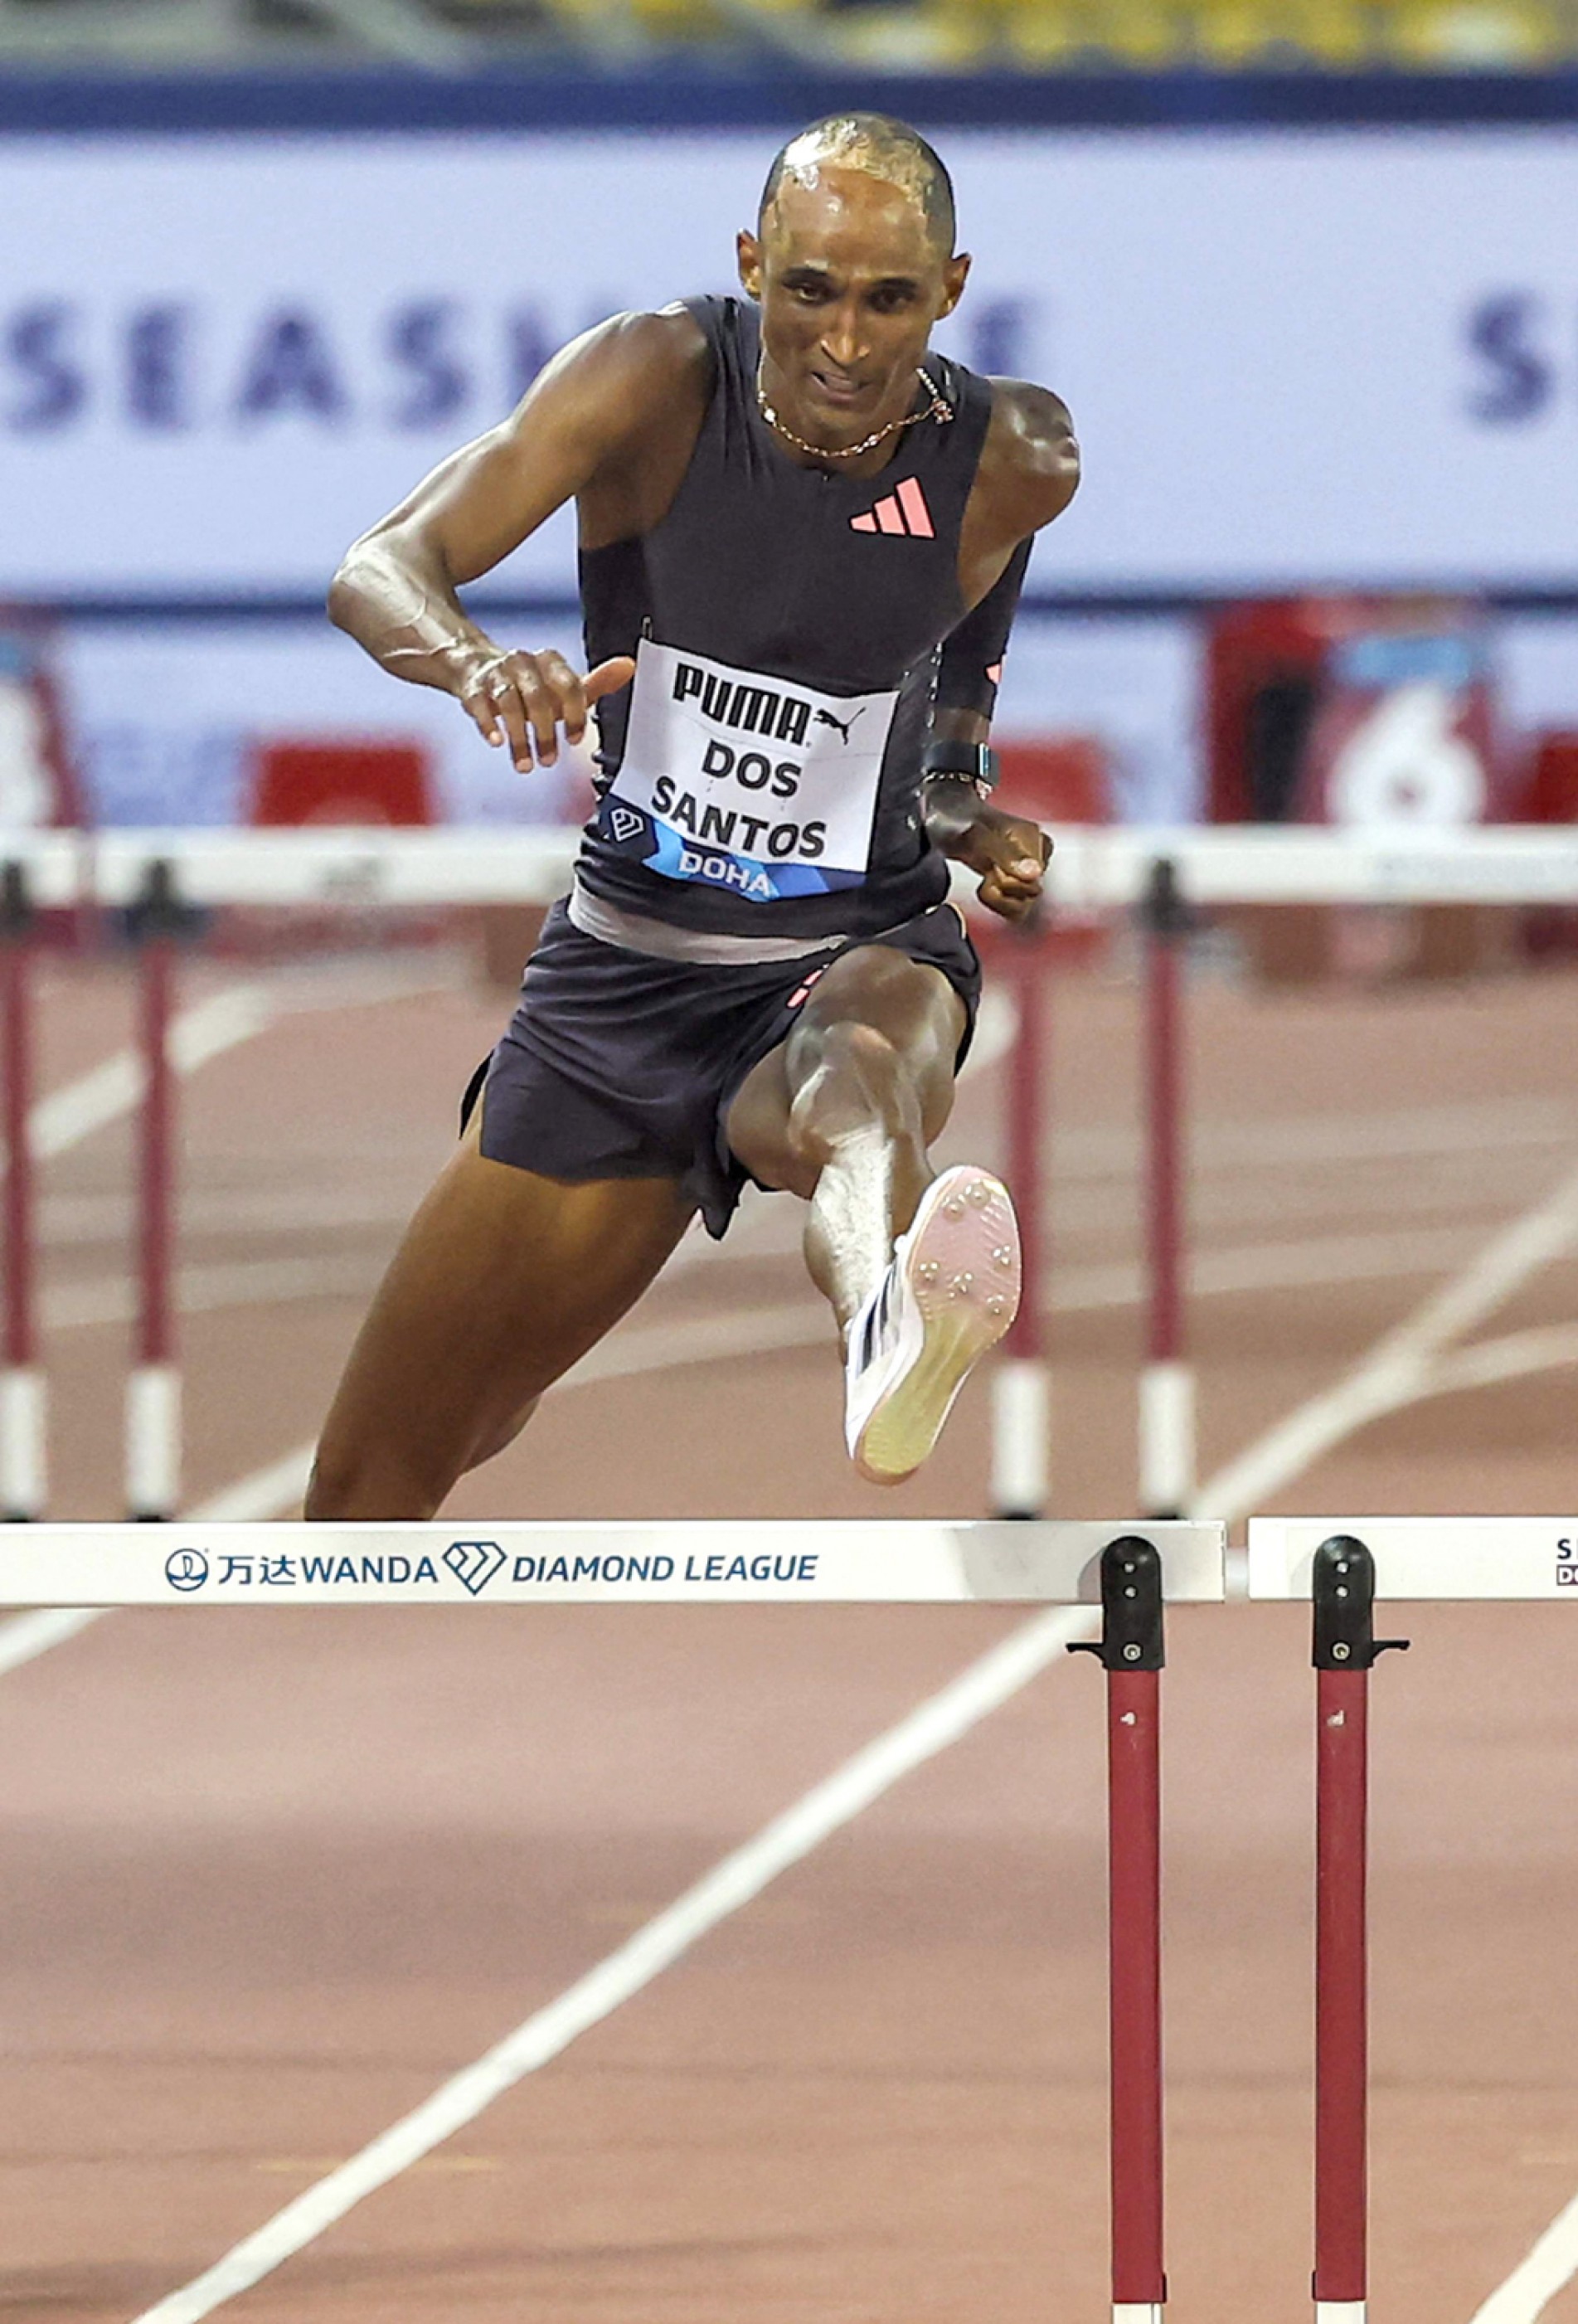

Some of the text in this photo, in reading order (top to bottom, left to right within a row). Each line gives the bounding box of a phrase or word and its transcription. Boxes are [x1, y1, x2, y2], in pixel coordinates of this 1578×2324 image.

[672, 663, 812, 746] PUMA
[702, 739, 802, 798] DOS
[651, 775, 828, 858] SANTOS
[678, 853, 772, 897] DOHA
[217, 1554, 819, 1585] 万达 WANDA DIAMOND LEAGUE
[1556, 1538, 1578, 1560] S
